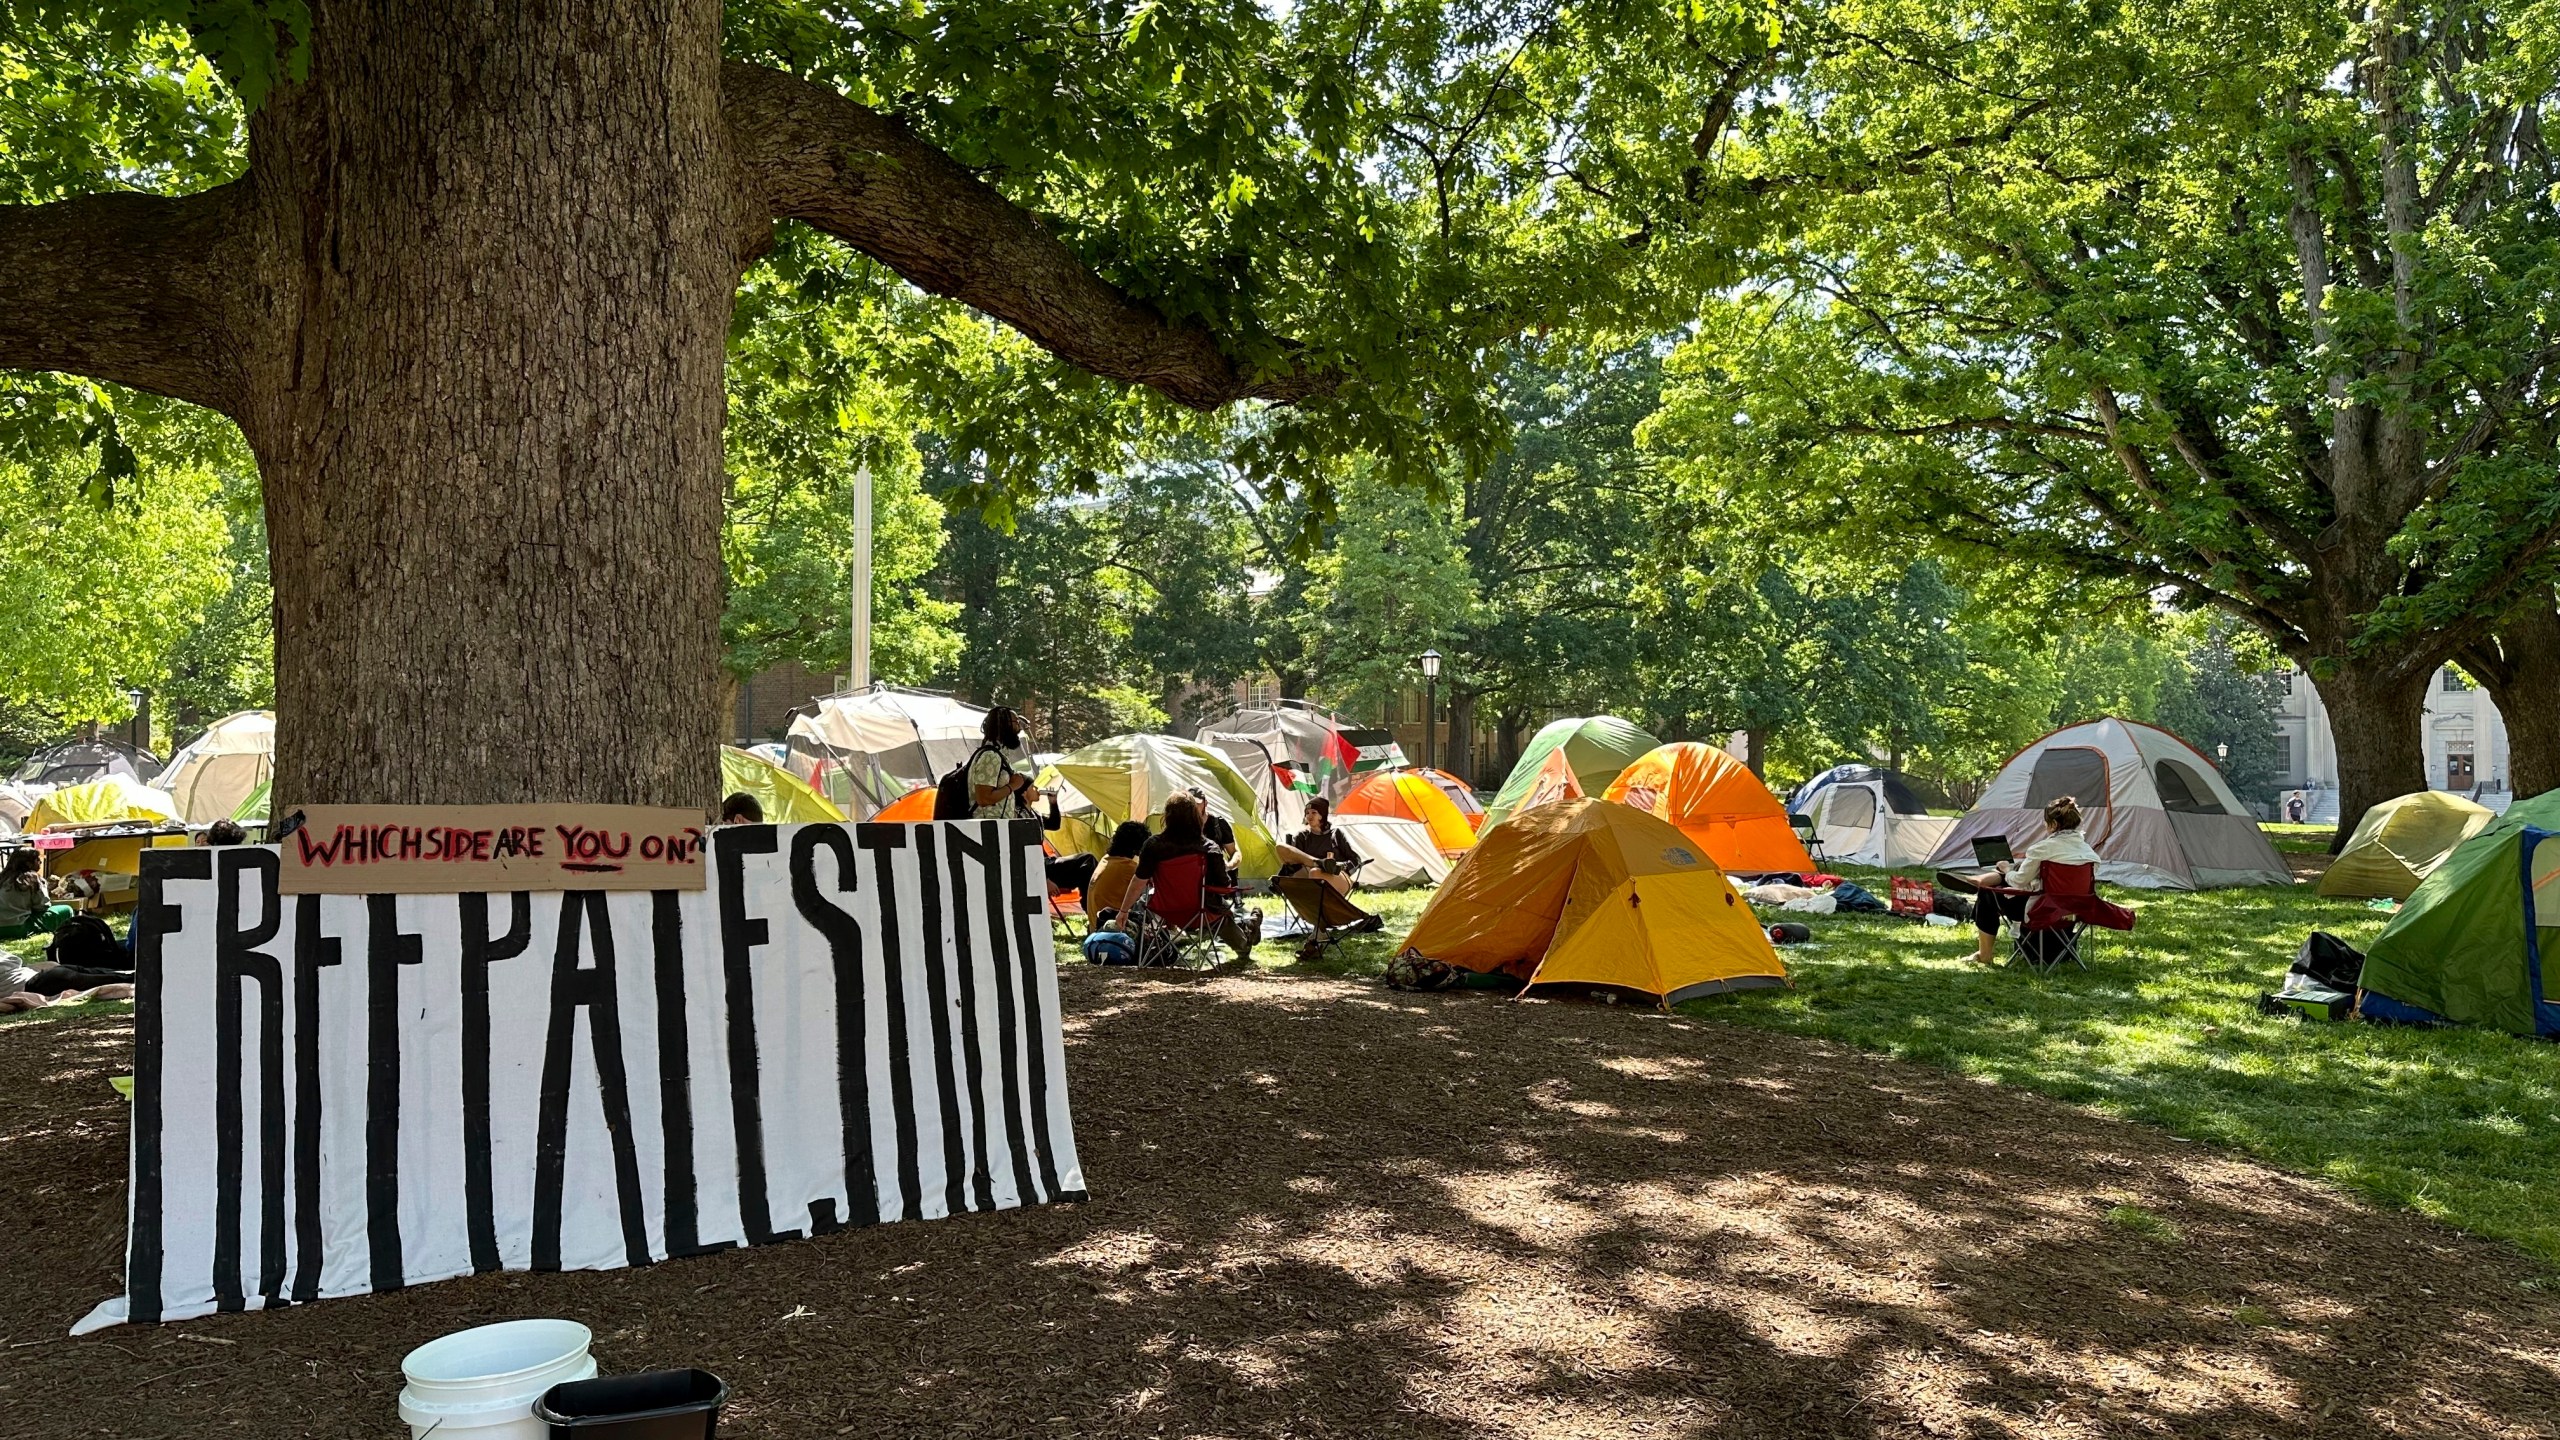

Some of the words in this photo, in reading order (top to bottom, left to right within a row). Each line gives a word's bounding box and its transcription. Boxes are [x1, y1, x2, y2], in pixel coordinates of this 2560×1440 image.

[297, 824, 422, 867] WHICH
[423, 826, 493, 861] SIDE
[493, 826, 546, 860] ARE
[555, 824, 632, 861] YOU
[640, 827, 703, 867] ON?
[458, 819, 1088, 1275] PALESTINE
